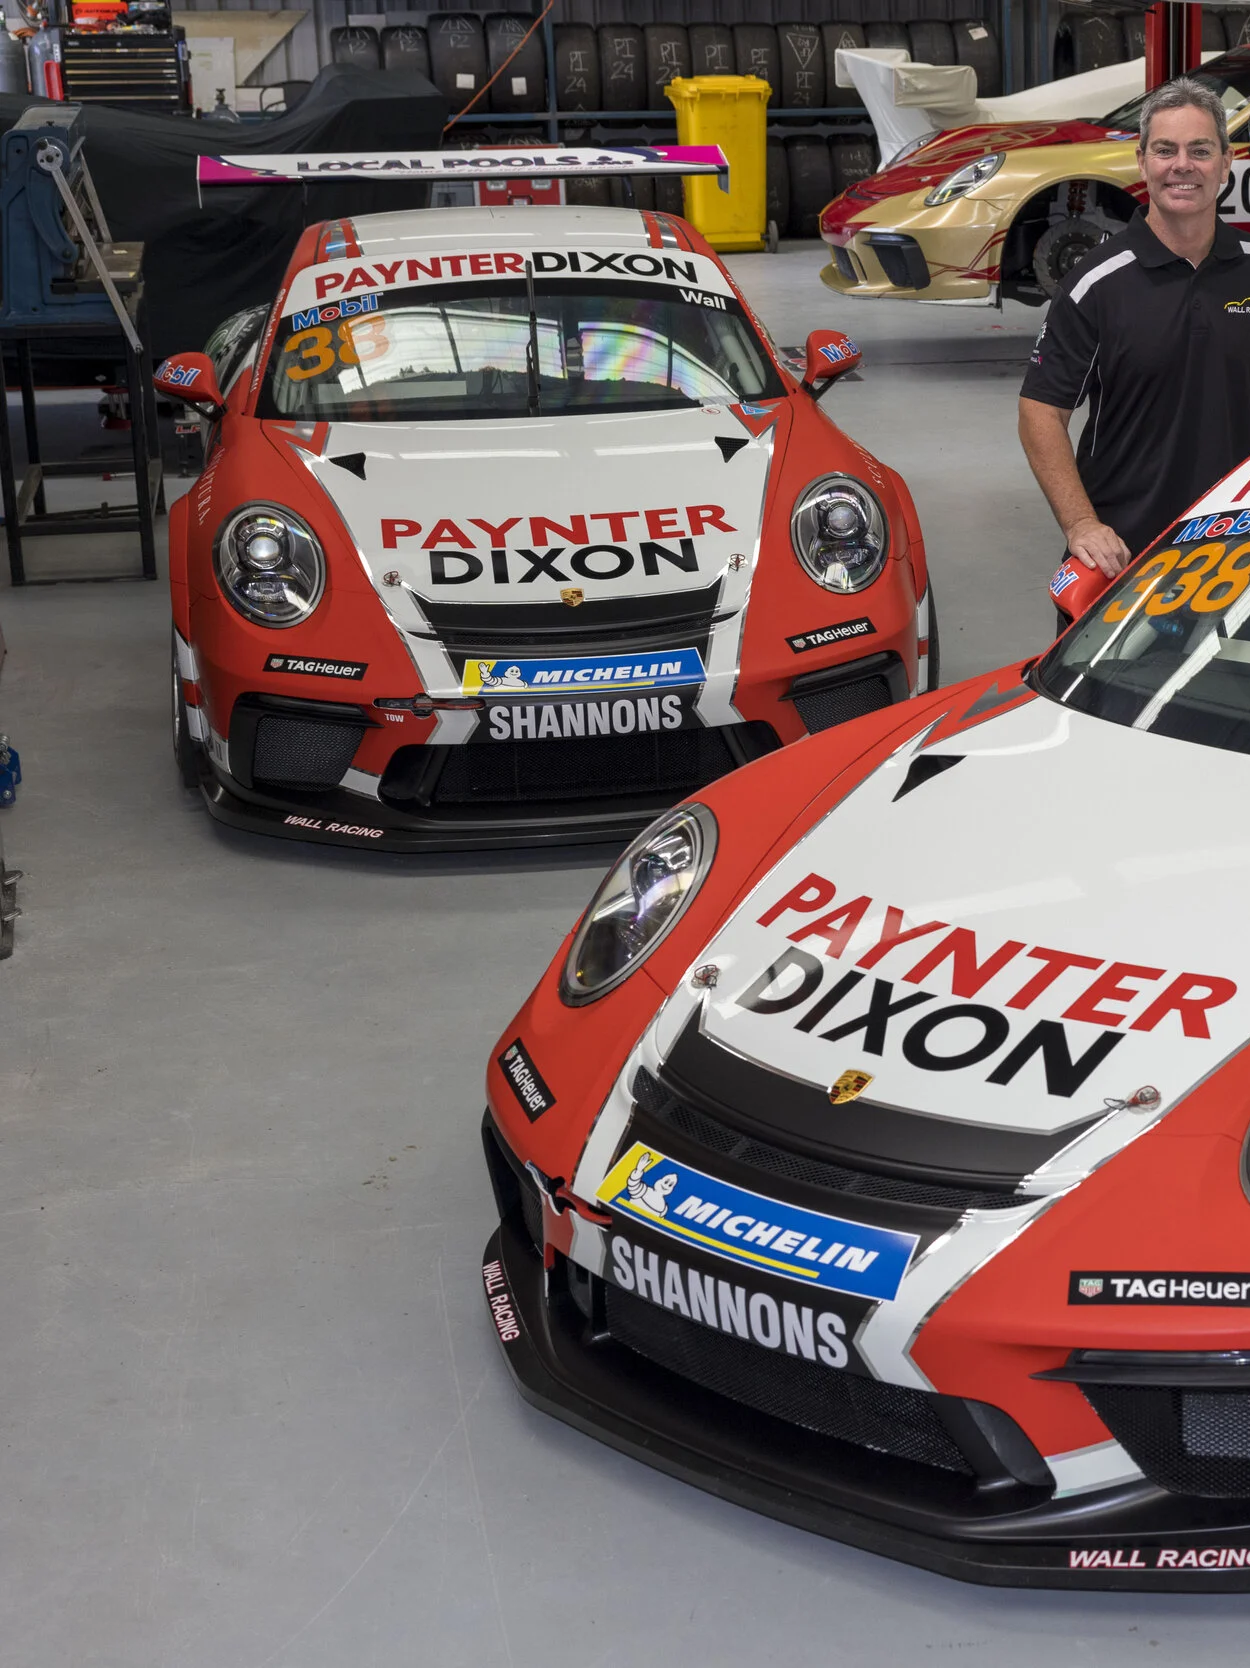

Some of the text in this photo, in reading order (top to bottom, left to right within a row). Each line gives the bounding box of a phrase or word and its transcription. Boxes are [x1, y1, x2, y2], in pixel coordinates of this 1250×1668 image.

[298, 158, 433, 172] LOCAL
[442, 155, 582, 170] POOLS
[292, 293, 380, 331] Mobil
[679, 288, 726, 311] Wall
[284, 314, 390, 382] 38
[380, 504, 738, 549] PAYNTER
[429, 538, 699, 585] DIXON
[532, 661, 682, 685] MICHELIN
[385, 714, 404, 723] TOW
[489, 695, 683, 740] SHANNONS
[284, 815, 384, 838] WALL RACING
[755, 872, 1238, 1040] PAYNTER
[734, 945, 1127, 1098] DIXON
[673, 1195, 879, 1273] MICHELIN
[482, 1259, 520, 1342] WALL RACING
[611, 1236, 848, 1369] SHANNONS
[1069, 1550, 1146, 1568] WALL
